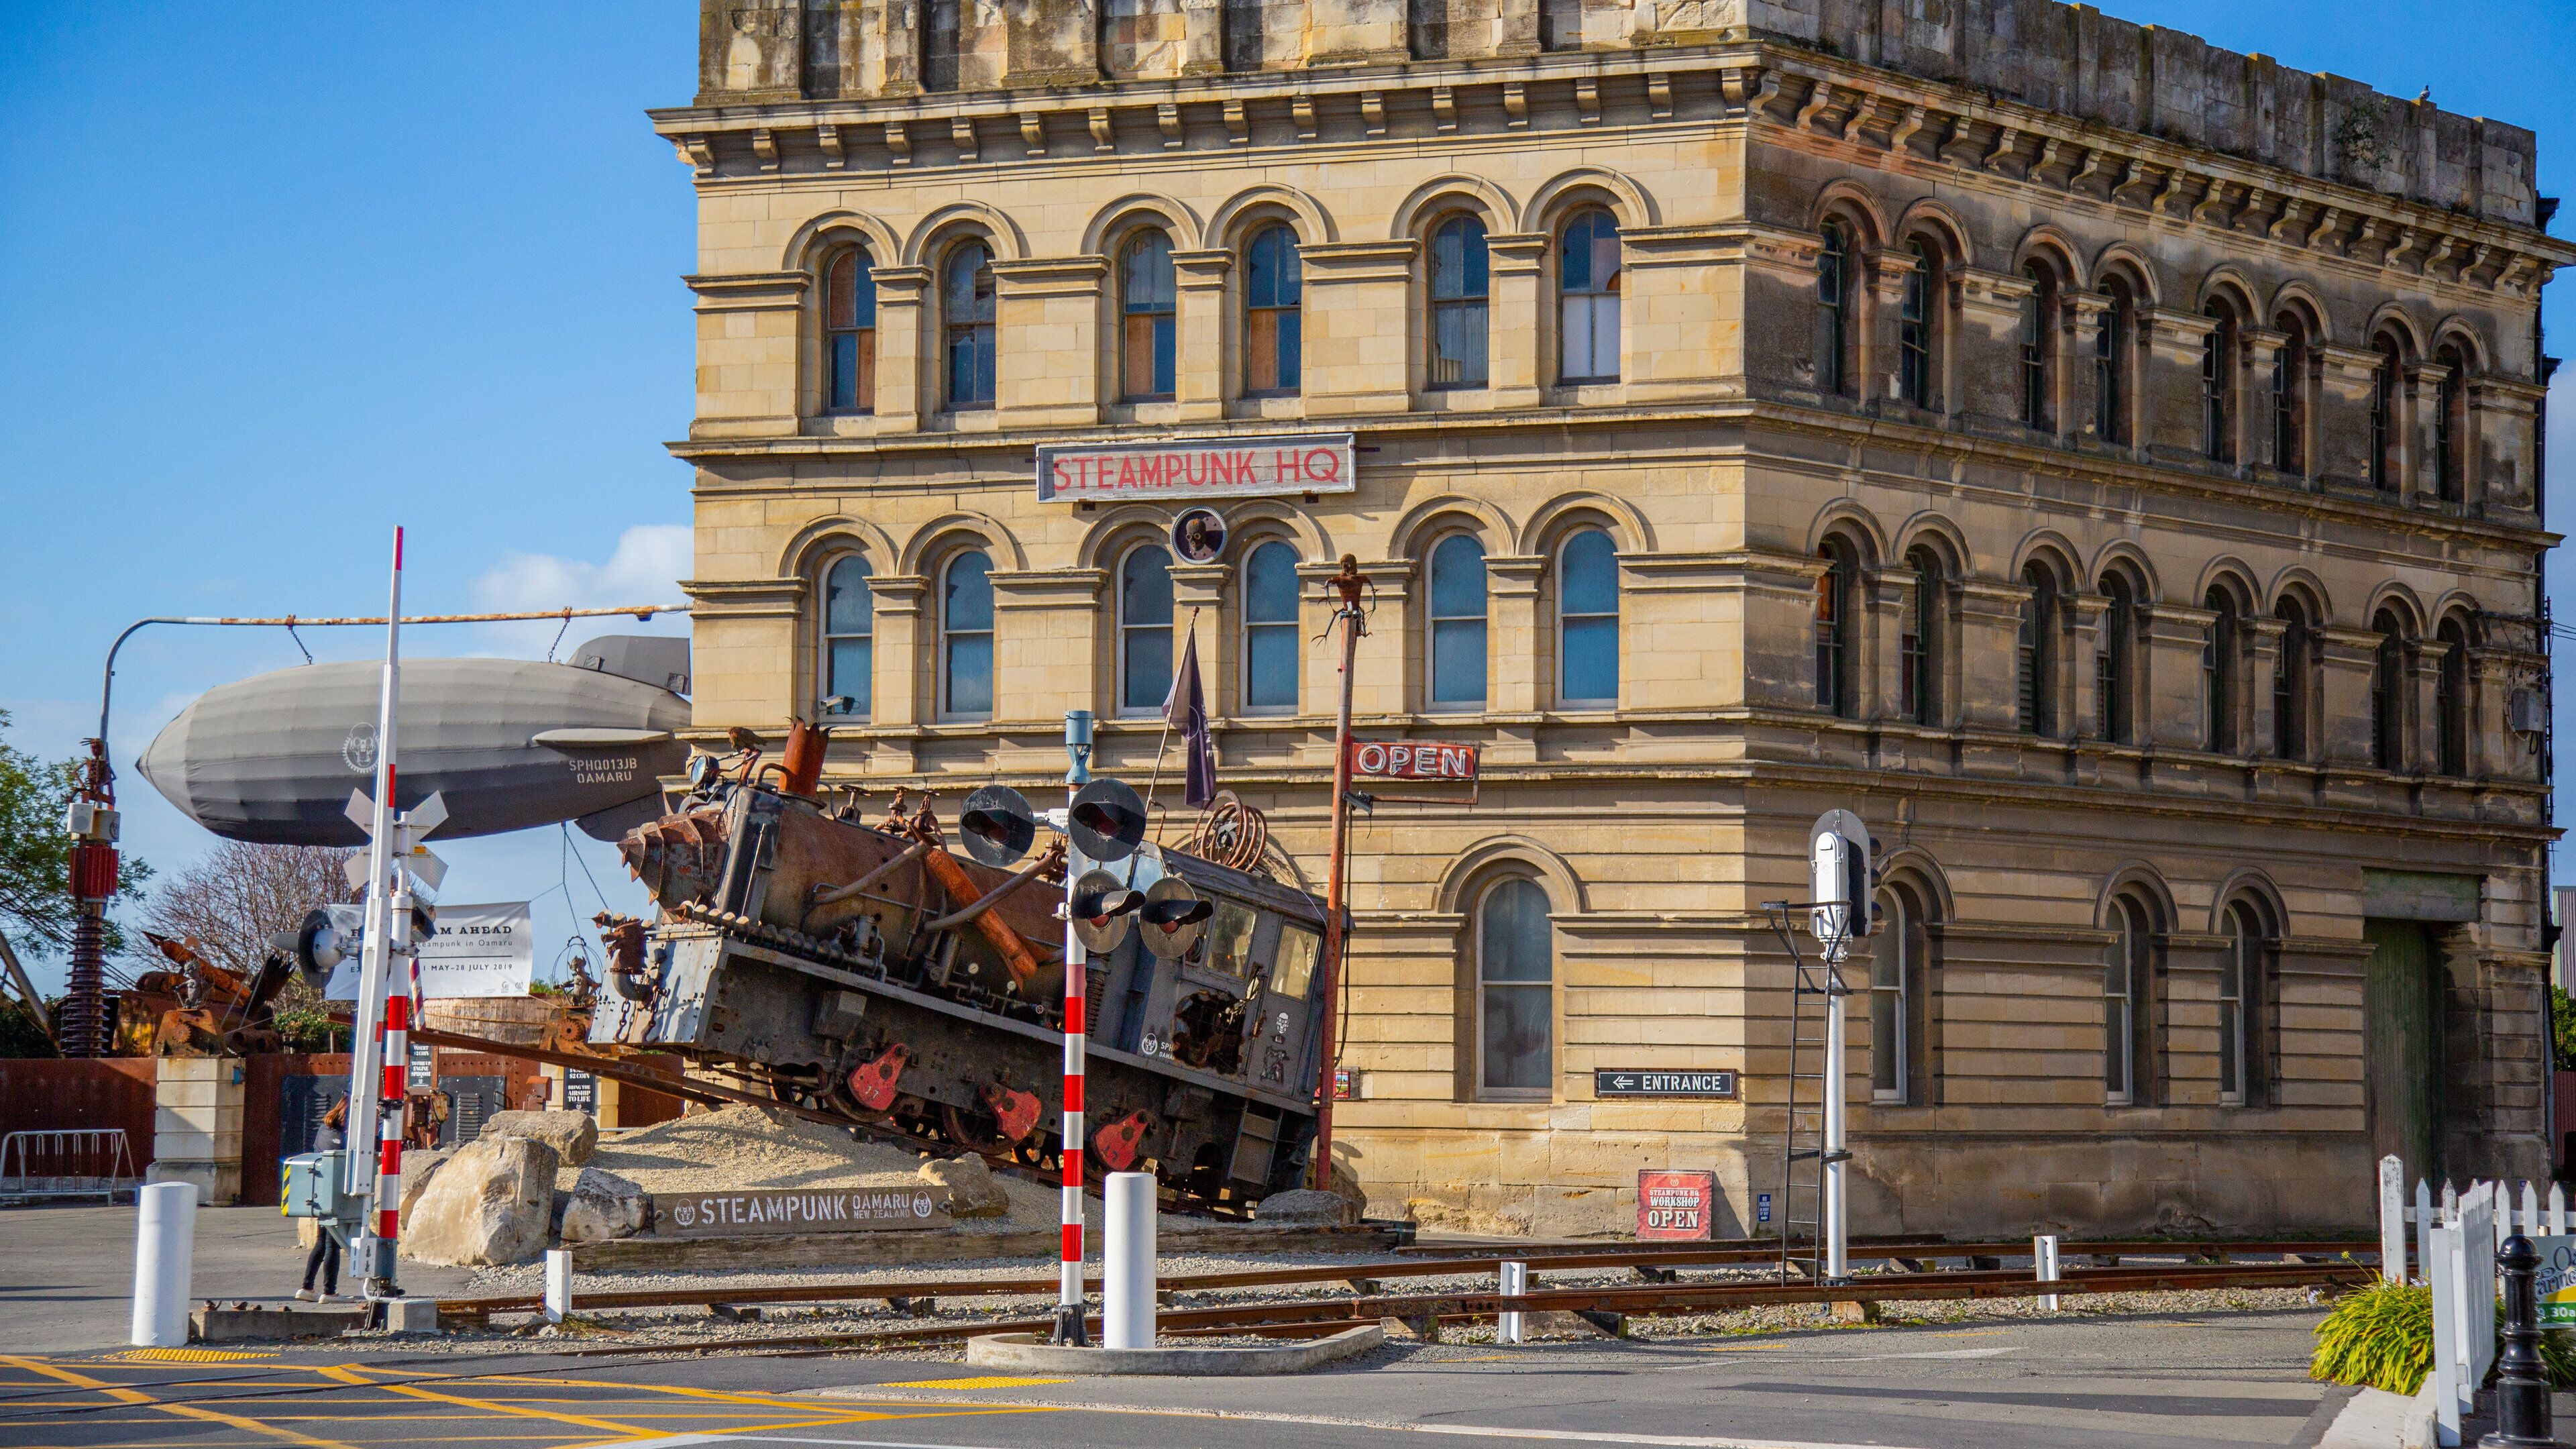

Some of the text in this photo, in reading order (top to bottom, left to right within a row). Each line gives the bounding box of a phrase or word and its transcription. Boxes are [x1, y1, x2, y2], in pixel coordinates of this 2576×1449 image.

[1053, 447, 1340, 491] STEAMPUNK HQ
[569, 758, 637, 771] SPHQ013JB
[1358, 744, 1466, 775] OPEN
[577, 771, 632, 784] OAMARU
[459, 926, 512, 934] AHEAD
[418, 941, 461, 949] teampunk
[468, 964, 489, 972] JULY
[1642, 1075, 1721, 1091] ENTRANCE
[1650, 1196, 1701, 1208] WORKSHOP
[700, 1193, 910, 1225] STEAMPUNK OAMARU
[853, 1209, 910, 1220] NEW ZEALAND
[1648, 1210, 1699, 1228] OPEN
